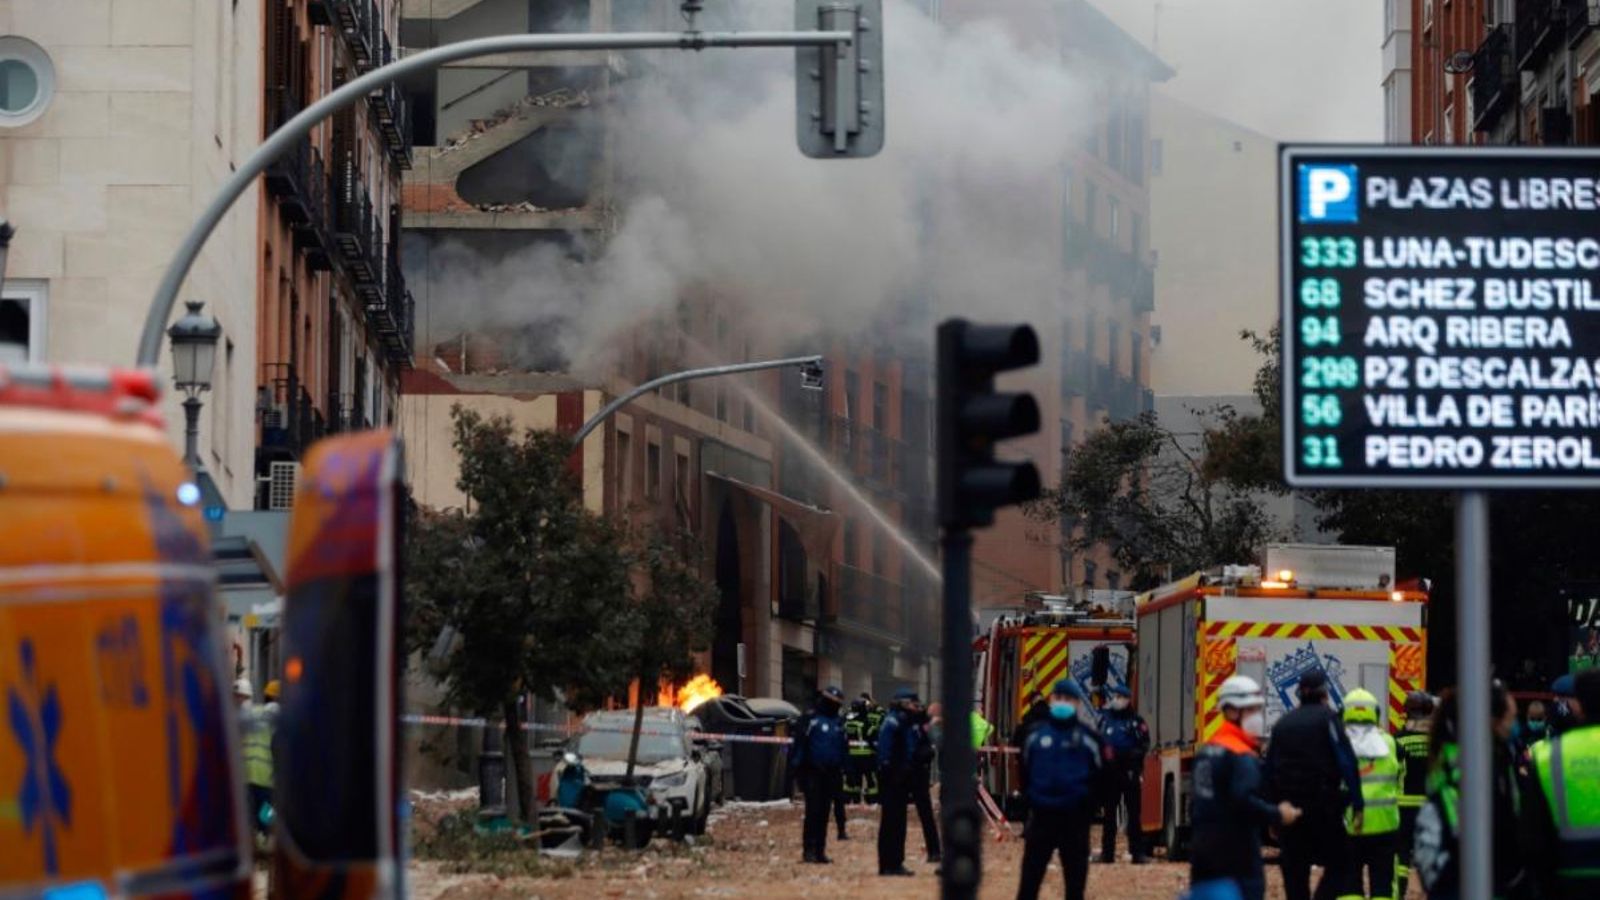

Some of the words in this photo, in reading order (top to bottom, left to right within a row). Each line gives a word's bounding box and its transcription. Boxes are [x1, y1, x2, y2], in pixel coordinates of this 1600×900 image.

[1308, 167, 1352, 219] P
[1366, 177, 1493, 208] PLAZAS
[1501, 177, 1600, 210] LIBRE
[1301, 236, 1357, 268] 333
[1301, 277, 1340, 309] 68
[1364, 277, 1477, 310] SCHEZ
[1484, 278, 1600, 310] BUSTIL
[1301, 315, 1341, 347] 94
[1364, 315, 1439, 355] ARQ
[1446, 315, 1572, 348] RIBERA
[1302, 355, 1358, 389] 298
[1364, 356, 1409, 389] PZ
[1302, 393, 1342, 426] 56
[1364, 394, 1462, 427] VILLA
[1467, 395, 1515, 427] DE
[1521, 391, 1600, 428] PARÍ
[1302, 435, 1341, 467] 31
[1365, 435, 1484, 468] PEDRO
[1490, 435, 1600, 468] ZEROL
